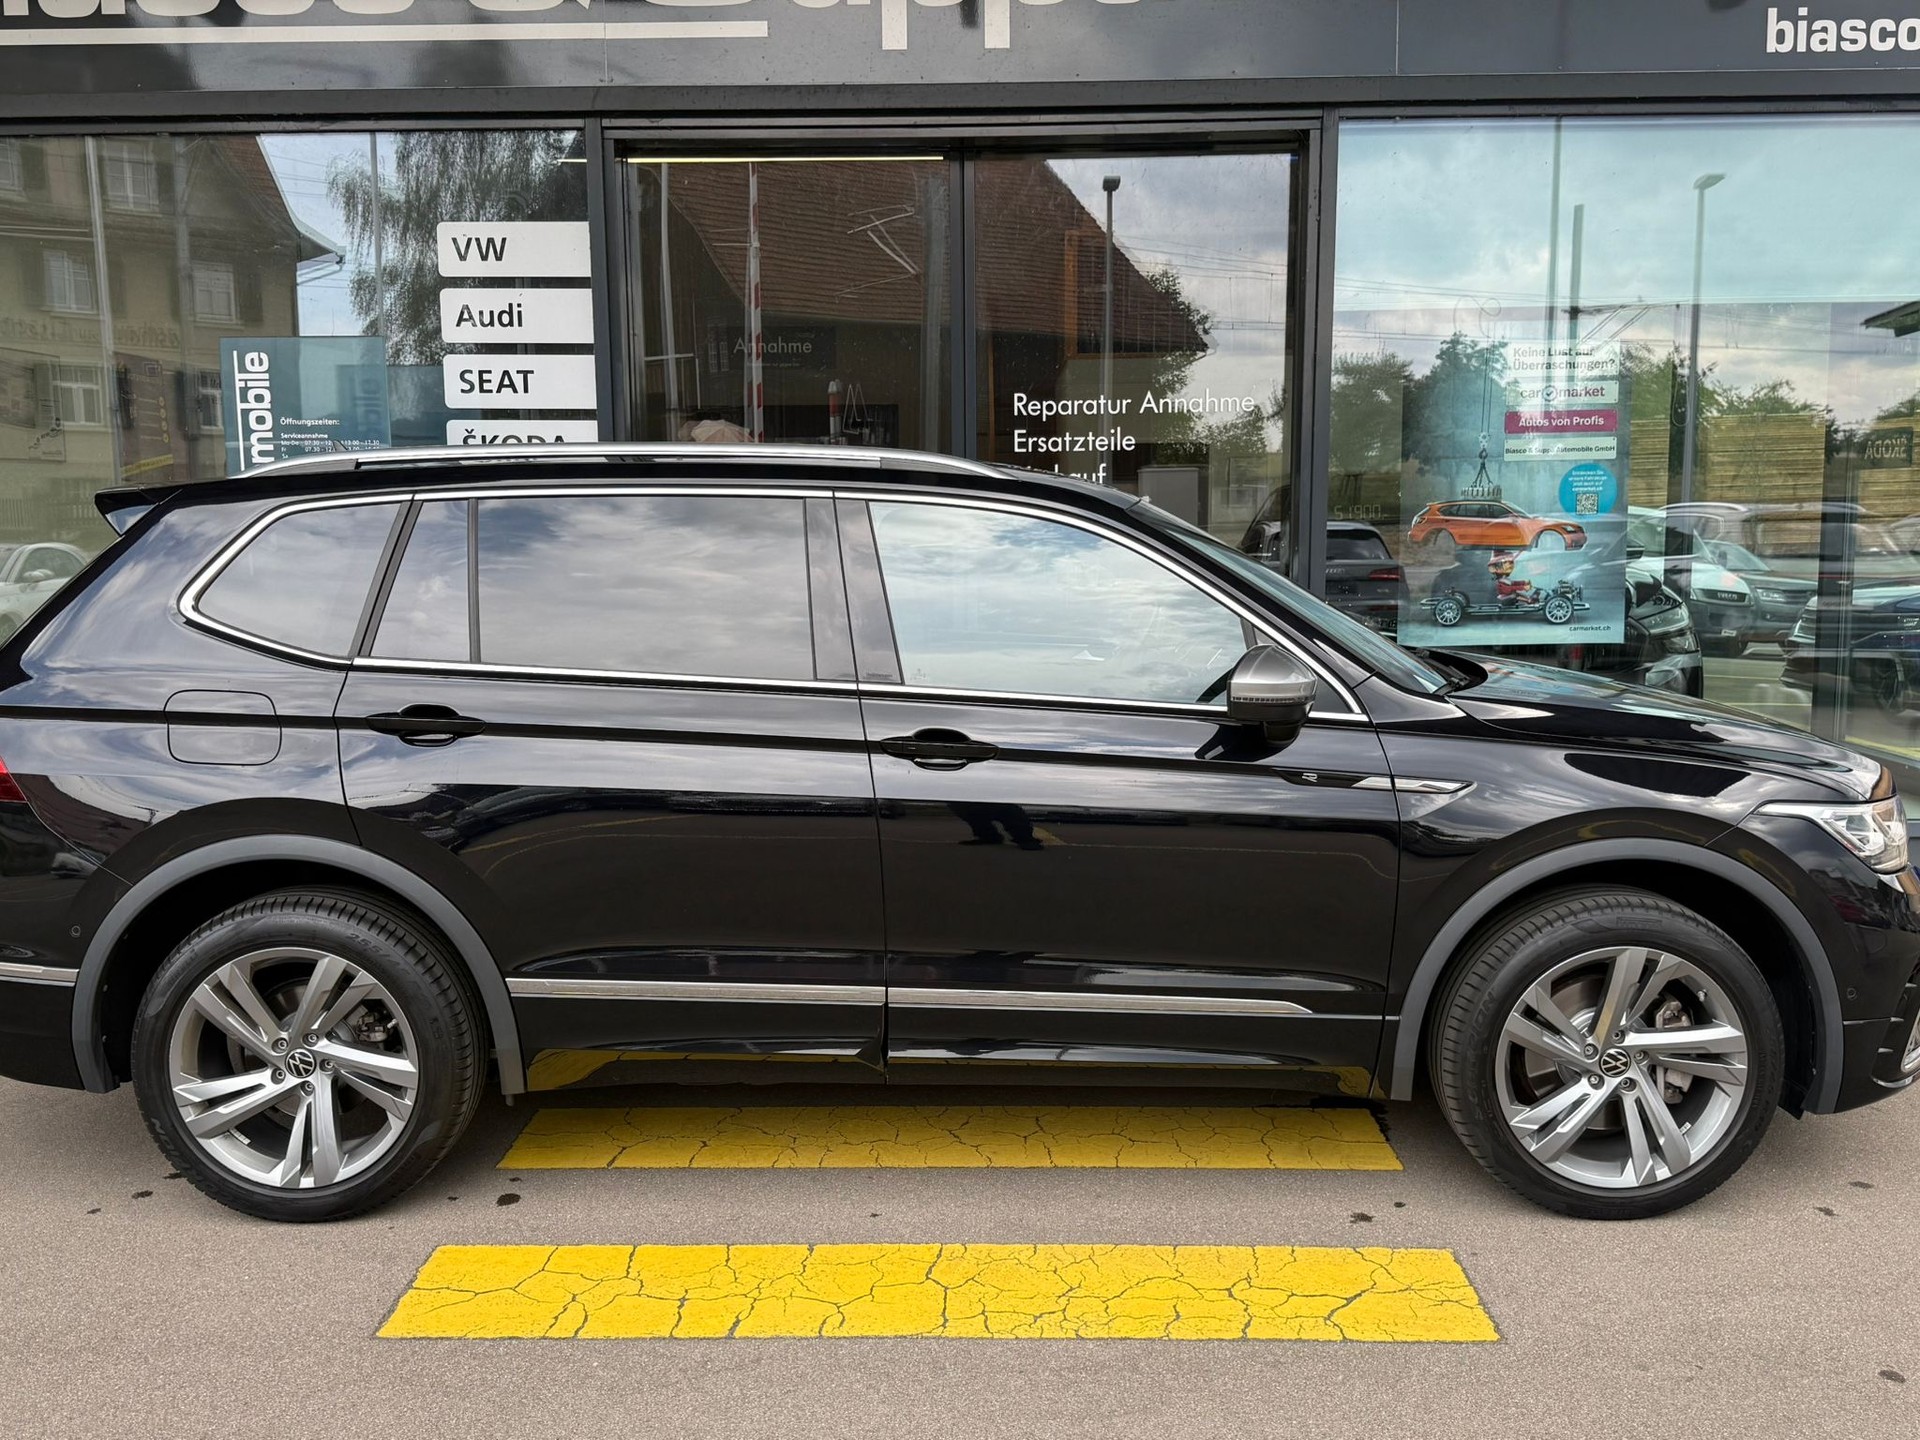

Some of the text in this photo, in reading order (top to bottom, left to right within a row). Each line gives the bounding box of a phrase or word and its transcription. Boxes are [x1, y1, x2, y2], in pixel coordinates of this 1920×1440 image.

[1766, 6, 1920, 53] biasco
[451, 236, 507, 262] VW
[455, 303, 523, 328] Audi
[733, 336, 812, 354] Annahme
[1513, 347, 1545, 357] Keine
[1548, 347, 1573, 356] Lust
[1513, 358, 1615, 371] Überraschungen?
[459, 369, 534, 394] SEAT
[1013, 388, 1255, 422] Reparatur Annahme
[280, 417, 340, 427] Öffnungszeiten:
[1518, 417, 1549, 427] Autos
[1573, 415, 1604, 425] Profis
[1013, 426, 1136, 453] Ersatzteile
